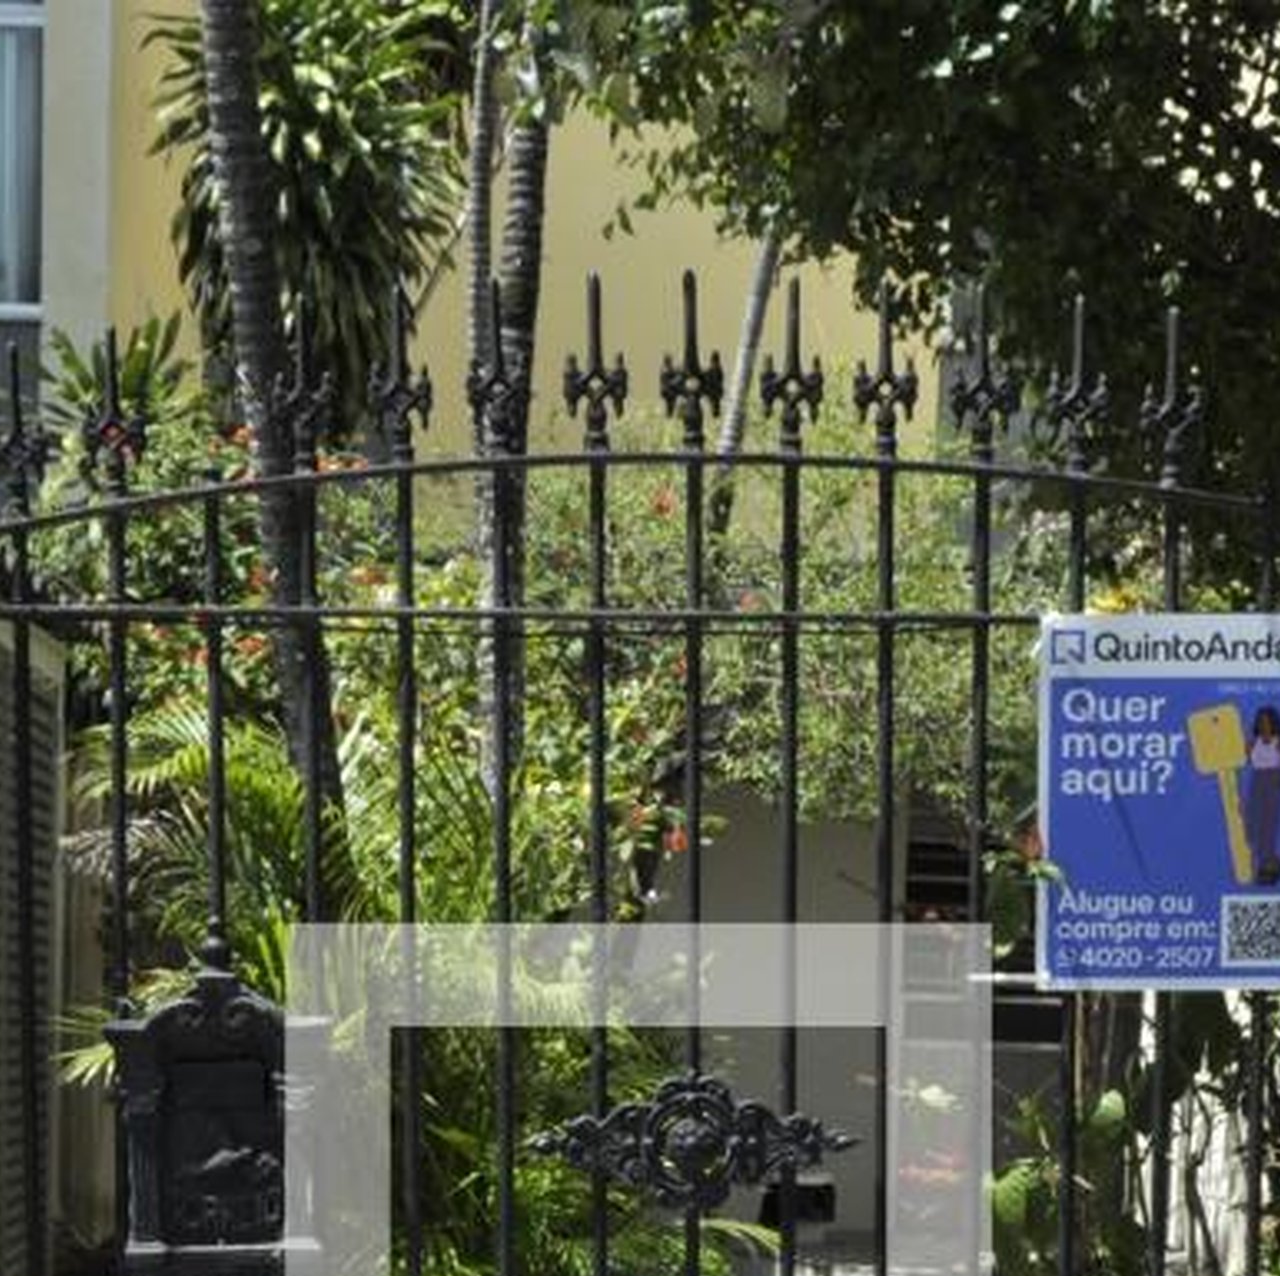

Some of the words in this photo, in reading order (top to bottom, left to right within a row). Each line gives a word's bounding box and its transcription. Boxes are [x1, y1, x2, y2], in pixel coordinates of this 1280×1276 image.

[1062, 689, 1166, 721] Quer
[1062, 733, 1185, 758] morar
[1061, 761, 1173, 801] aqui?
[1058, 888, 1154, 920] Alugue
[1160, 895, 1193, 914] ou
[1058, 921, 1161, 942] compre
[1167, 921, 1216, 938] em:
